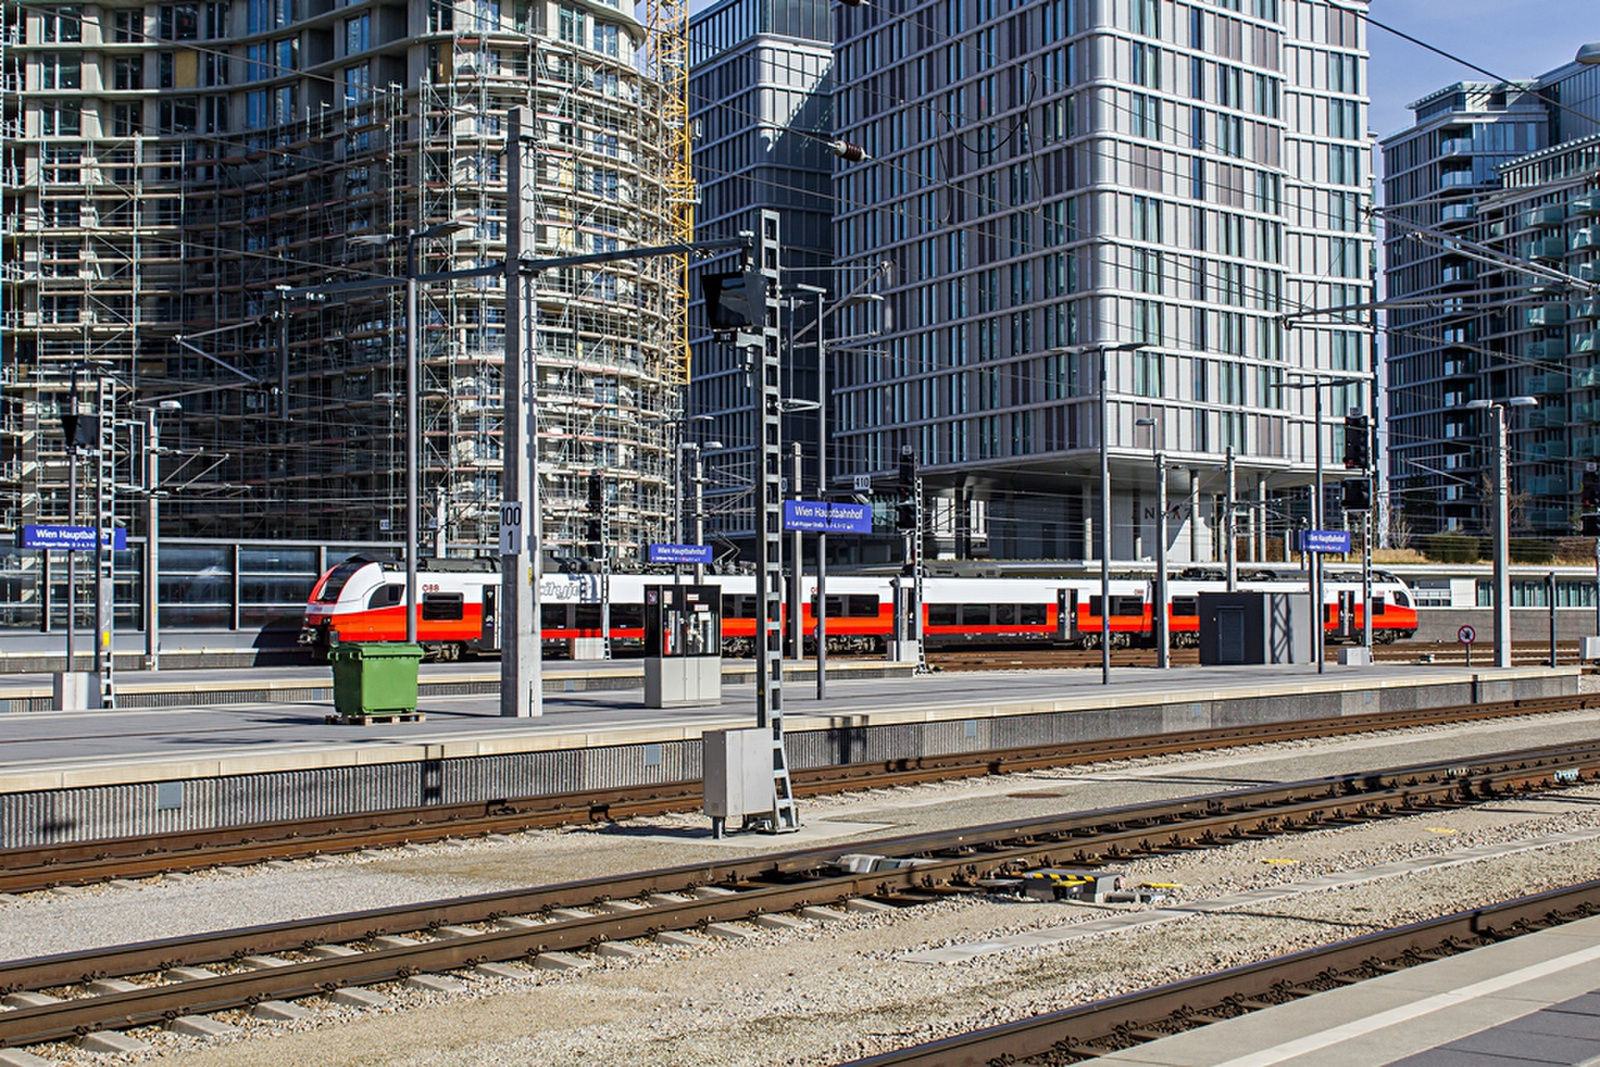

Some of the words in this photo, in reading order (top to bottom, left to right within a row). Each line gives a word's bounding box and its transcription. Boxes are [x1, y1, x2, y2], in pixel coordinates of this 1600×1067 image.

[501, 507, 521, 526] 100
[794, 506, 813, 516] Wien
[814, 507, 863, 519] Hauptbahnhof
[36, 529, 57, 538] Wien
[508, 530, 513, 550] 1
[672, 548, 706, 556] Hauptbahnhof
